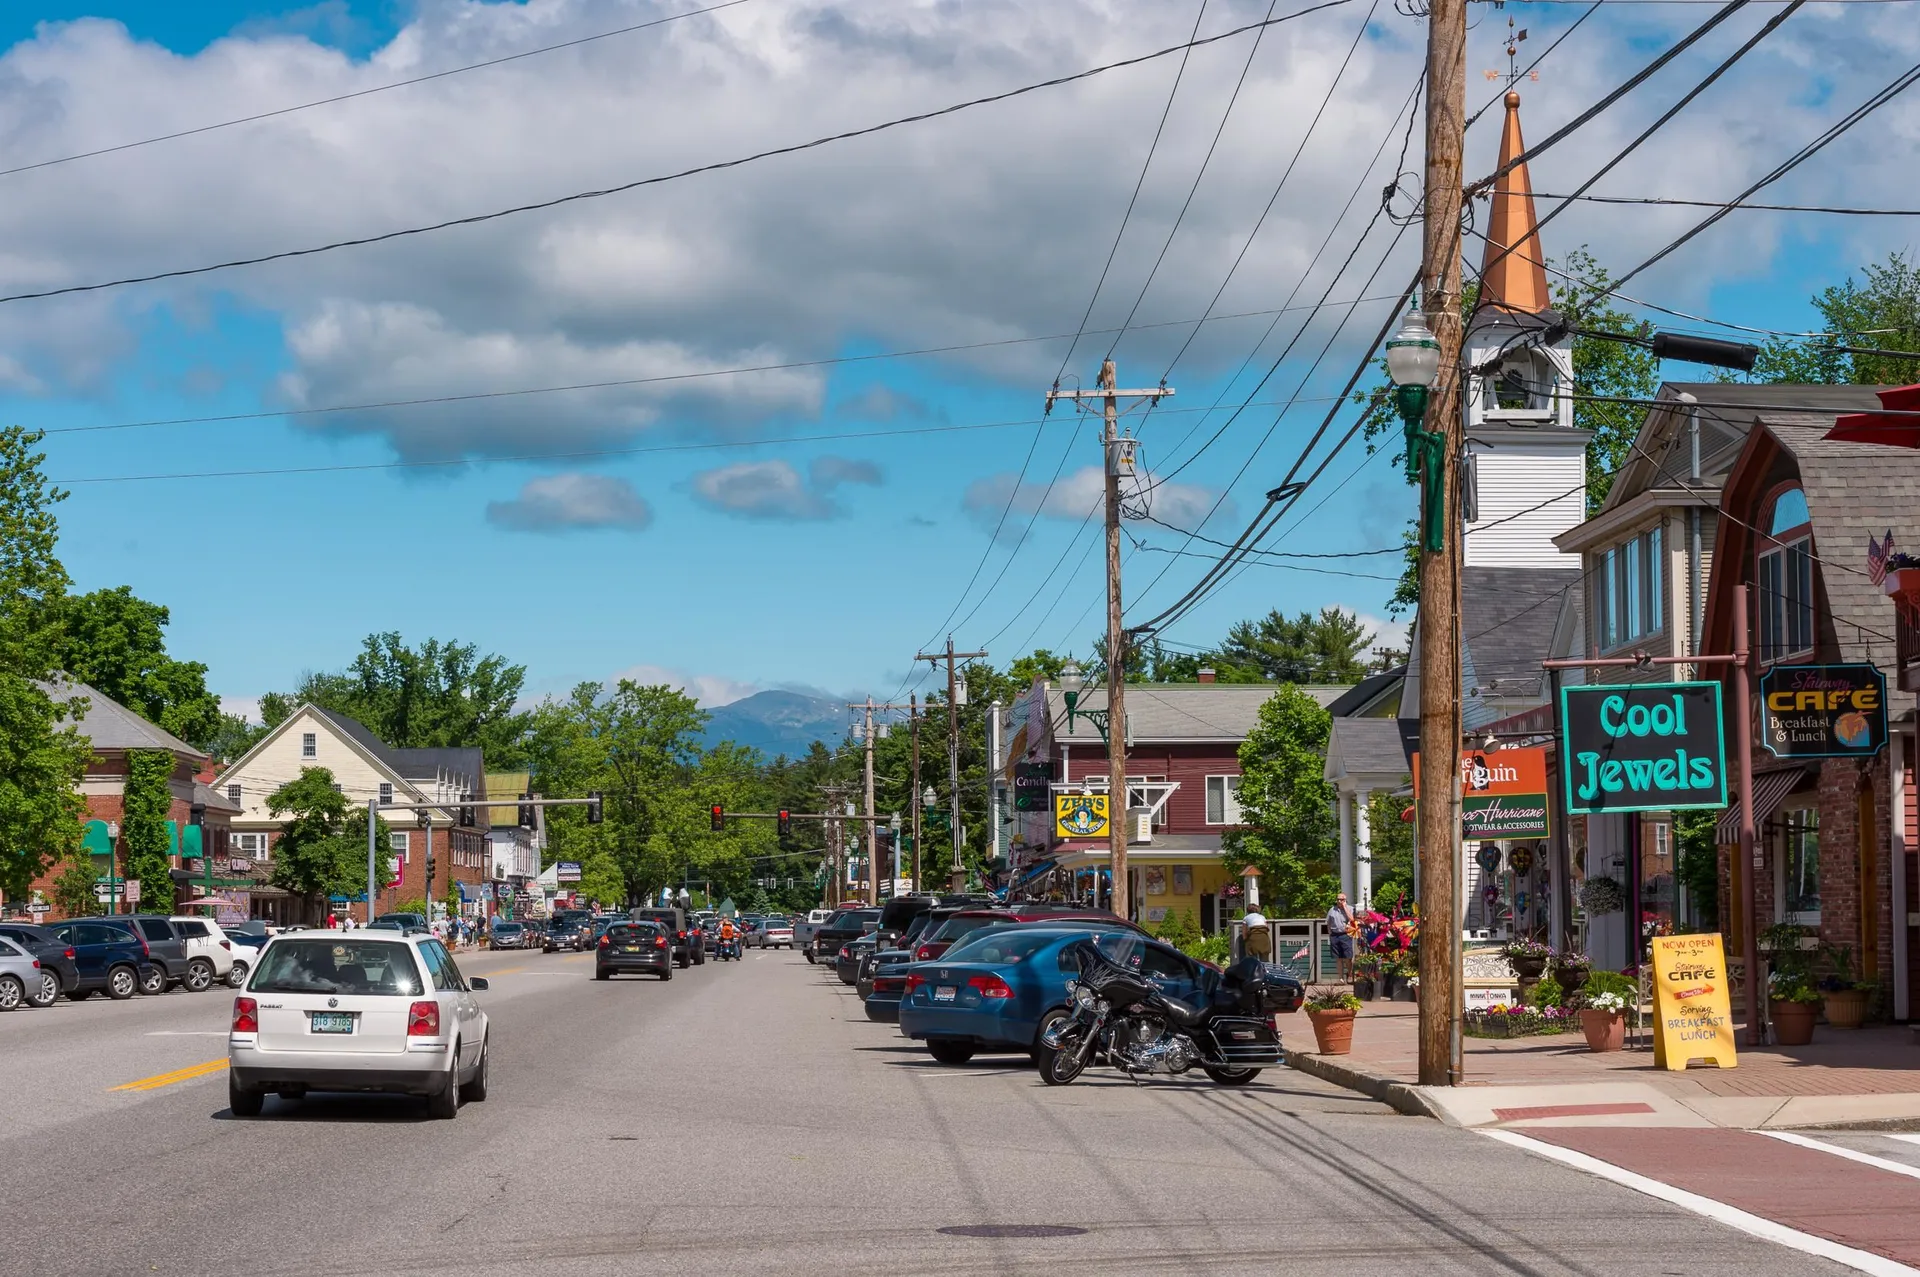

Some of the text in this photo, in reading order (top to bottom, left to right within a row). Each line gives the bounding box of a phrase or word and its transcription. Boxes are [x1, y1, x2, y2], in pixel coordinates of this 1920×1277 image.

[1768, 684, 1879, 711] CAFÉ
[1600, 694, 1688, 738] Cool
[1770, 716, 1831, 729] Breakfast
[1776, 730, 1827, 742] & Lunch
[1462, 763, 1519, 787] nguin
[1576, 749, 1714, 800] Jewels
[1061, 797, 1105, 812] ZEB'S
[1477, 798, 1545, 823] Hurricane
[1061, 819, 1106, 834] GENERAL STORE
[1463, 824, 1496, 832] OOTWEAR
[1503, 821, 1545, 830] ACCESSORIES
[1662, 939, 1715, 949] NOW OPEN
[1668, 967, 1716, 981] CAFÉ
[1680, 1006, 1714, 1019] Serving
[1668, 1017, 1724, 1029] BREAKFAST
[1681, 1031, 1716, 1041] LUNCH
